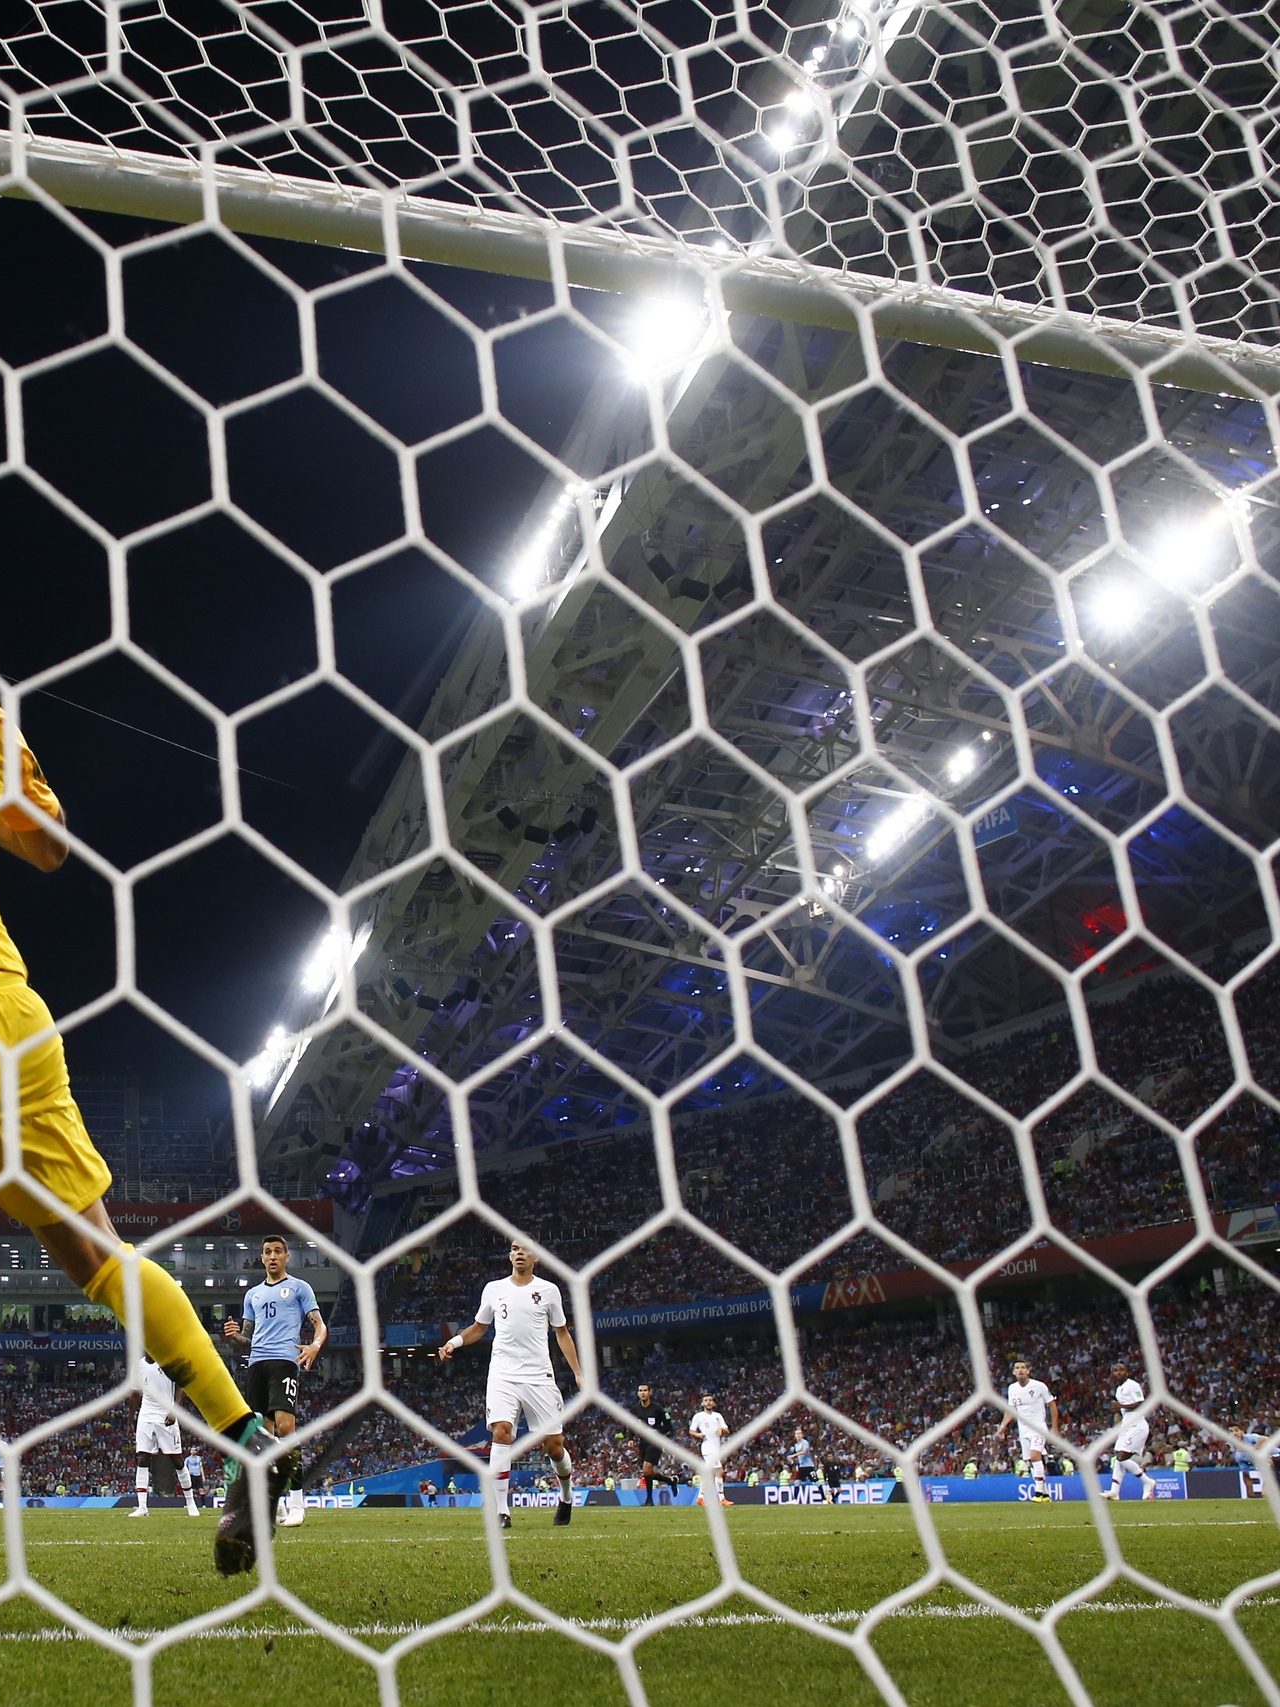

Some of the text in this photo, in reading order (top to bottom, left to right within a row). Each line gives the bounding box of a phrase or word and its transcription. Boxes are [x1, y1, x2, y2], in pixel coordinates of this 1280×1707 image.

[973, 806, 1011, 834] FIFA
[109, 1213, 159, 1227] orldcup
[998, 1258, 1038, 1277] SOCHI
[261, 1301, 277, 1320] 15
[501, 1303, 508, 1320] 3
[596, 1294, 801, 1329] МИРА ПО ФУТБОЛУ FIFA 2018 В РОИ
[50, 1339, 76, 1350] CUP
[78, 1339, 124, 1350] RUSSIA
[281, 1376, 298, 1397] 15
[1033, 1435, 1044, 1446] 23
[512, 1492, 583, 1508] POWERE
[1017, 1482, 1063, 1501] SOHI
[1156, 1490, 1173, 1499] 2018
[213, 1495, 354, 1508] PADE
